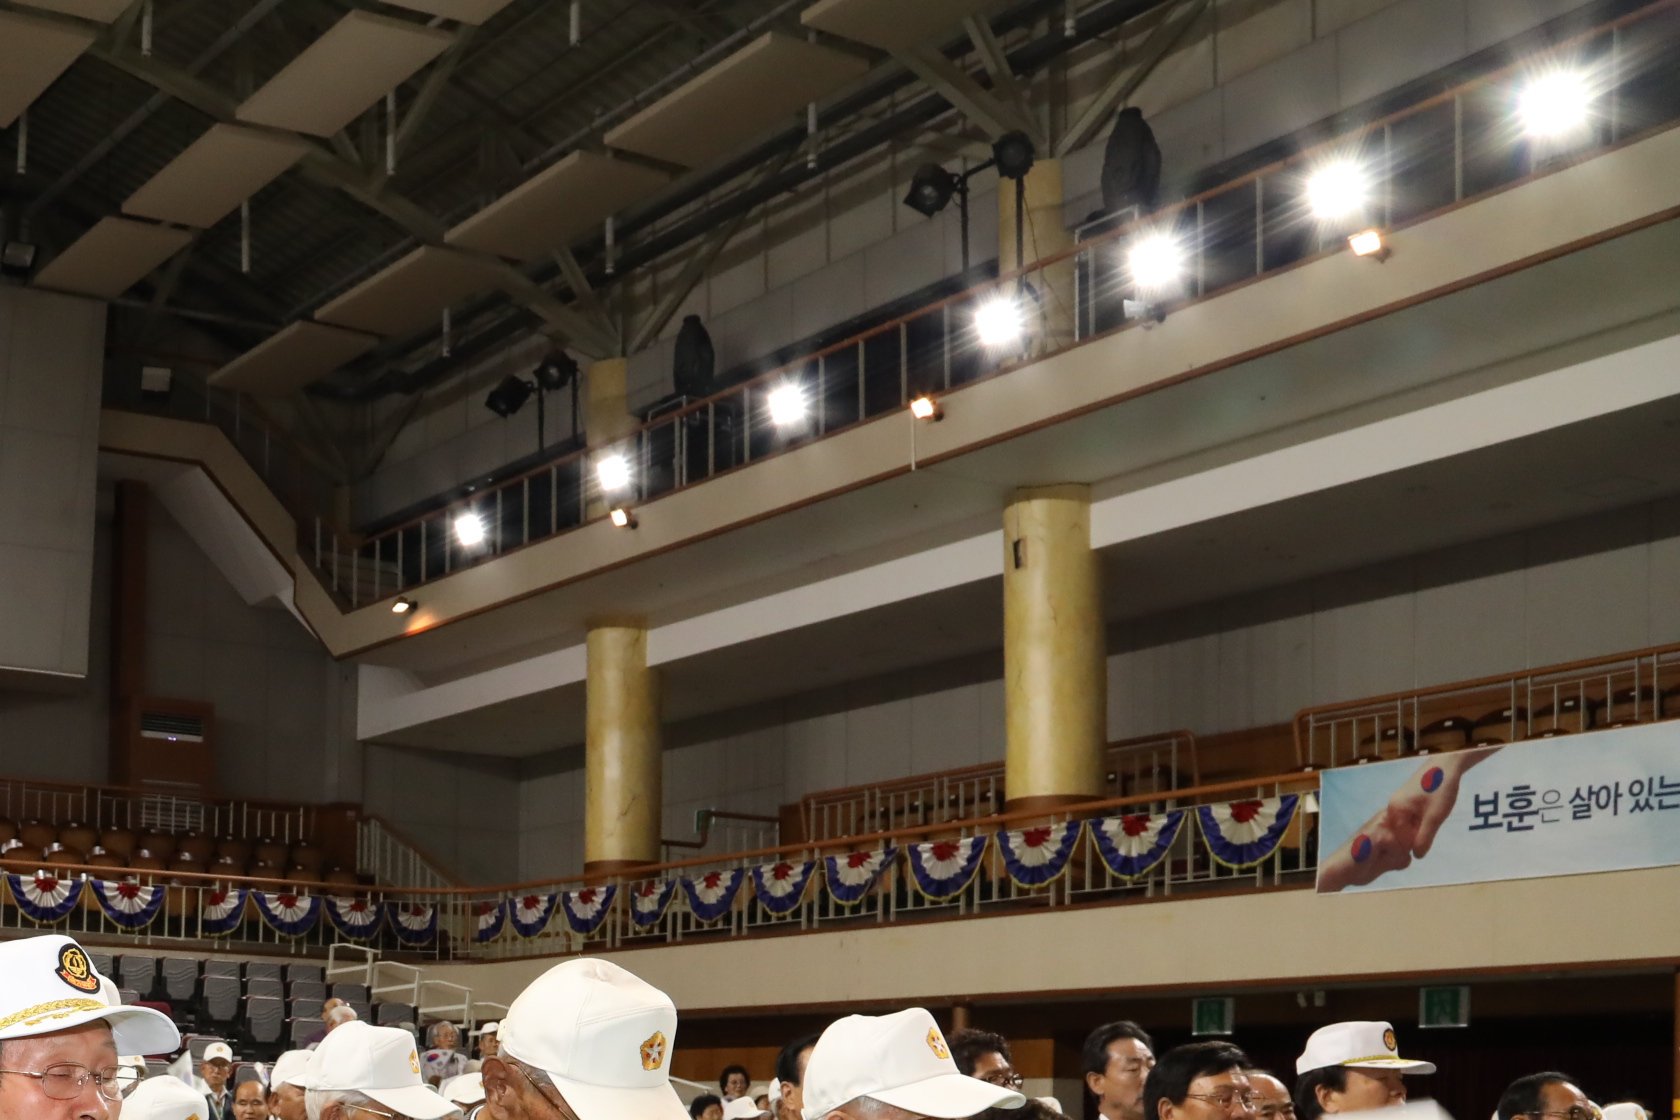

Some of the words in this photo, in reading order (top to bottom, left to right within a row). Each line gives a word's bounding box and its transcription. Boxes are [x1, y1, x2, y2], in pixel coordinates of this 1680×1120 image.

[1468, 784, 1564, 833] 보훈은
[1568, 781, 1623, 821] 살아
[1628, 775, 1680, 814] 있는
